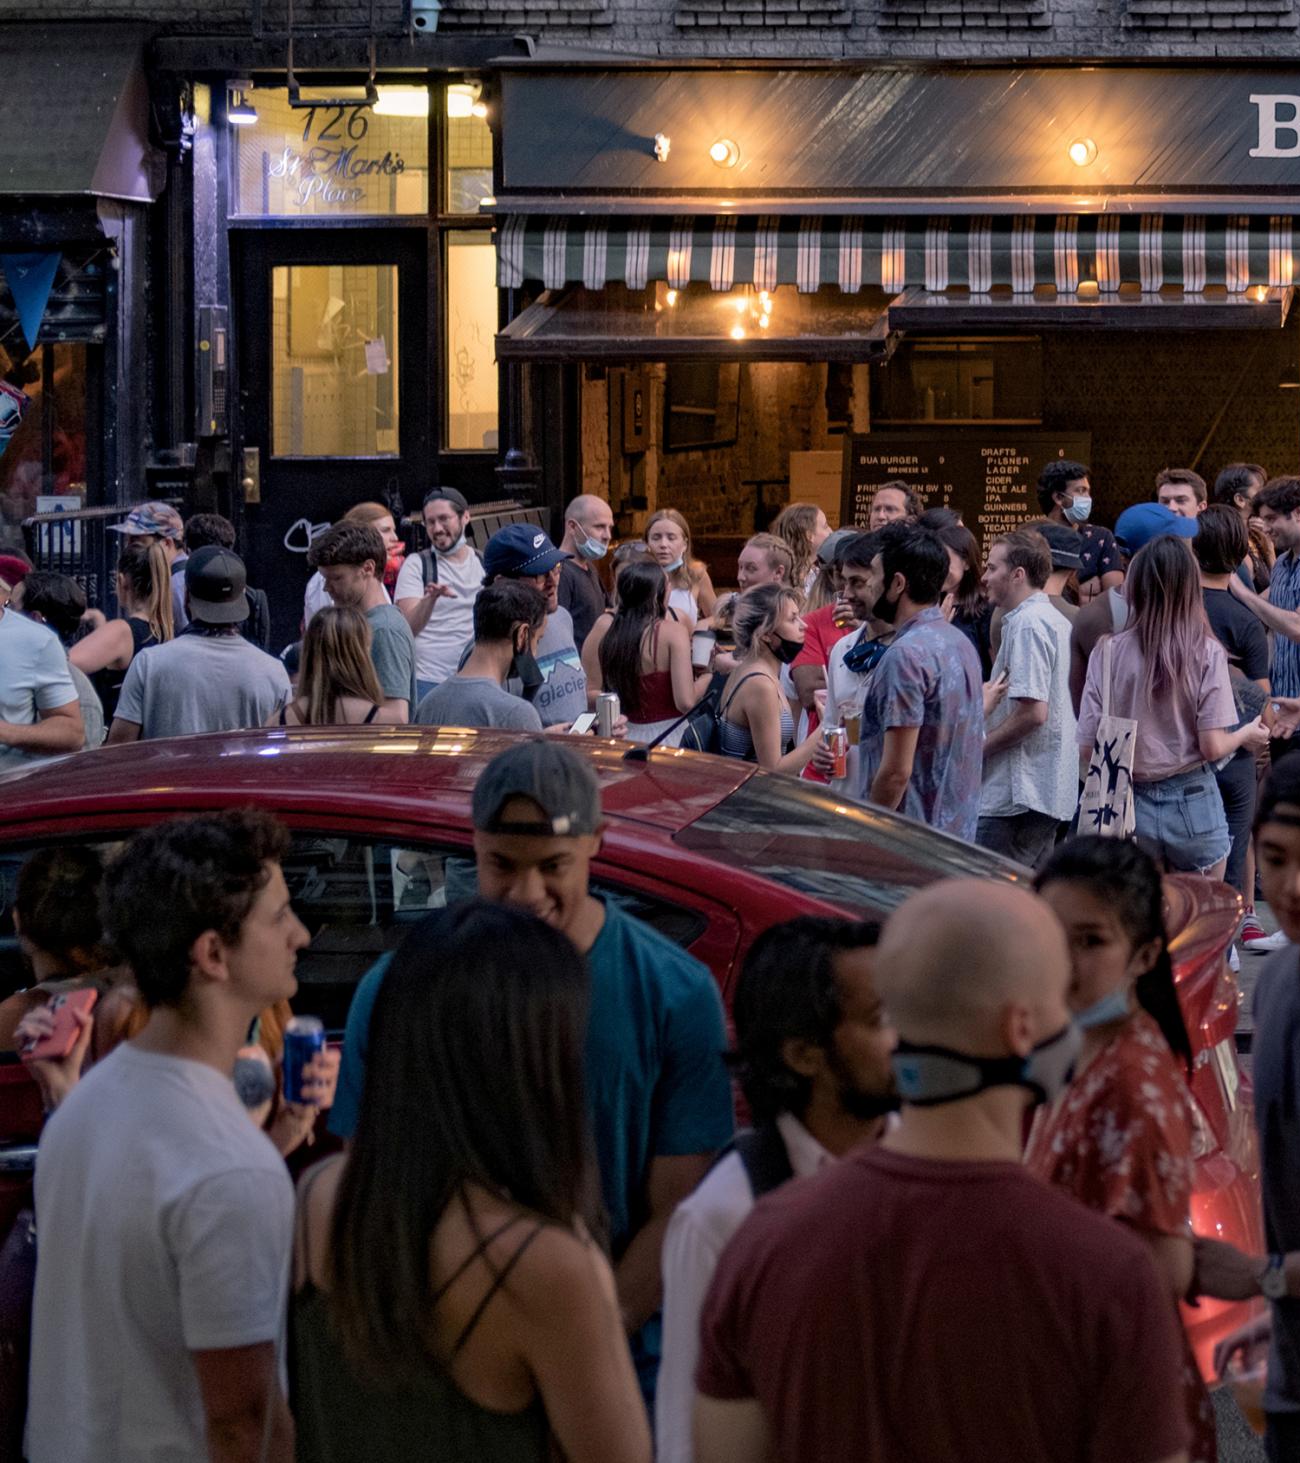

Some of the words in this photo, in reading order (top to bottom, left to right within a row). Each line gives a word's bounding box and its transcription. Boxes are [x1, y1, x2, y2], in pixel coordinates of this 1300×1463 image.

[302, 104, 369, 141] 126
[296, 175, 366, 206] Place
[981, 448, 1016, 456] DRAFTS
[860, 456, 878, 464] BUA
[880, 456, 918, 464] BURGER
[944, 484, 953, 492] 10
[985, 485, 1008, 493] PALE
[1010, 485, 1027, 493] ALE
[983, 503, 1028, 511] GUINNESS
[977, 515, 1016, 523] BOTTLES
[984, 524, 1016, 532] TECATE
[540, 677, 586, 708] glacie
